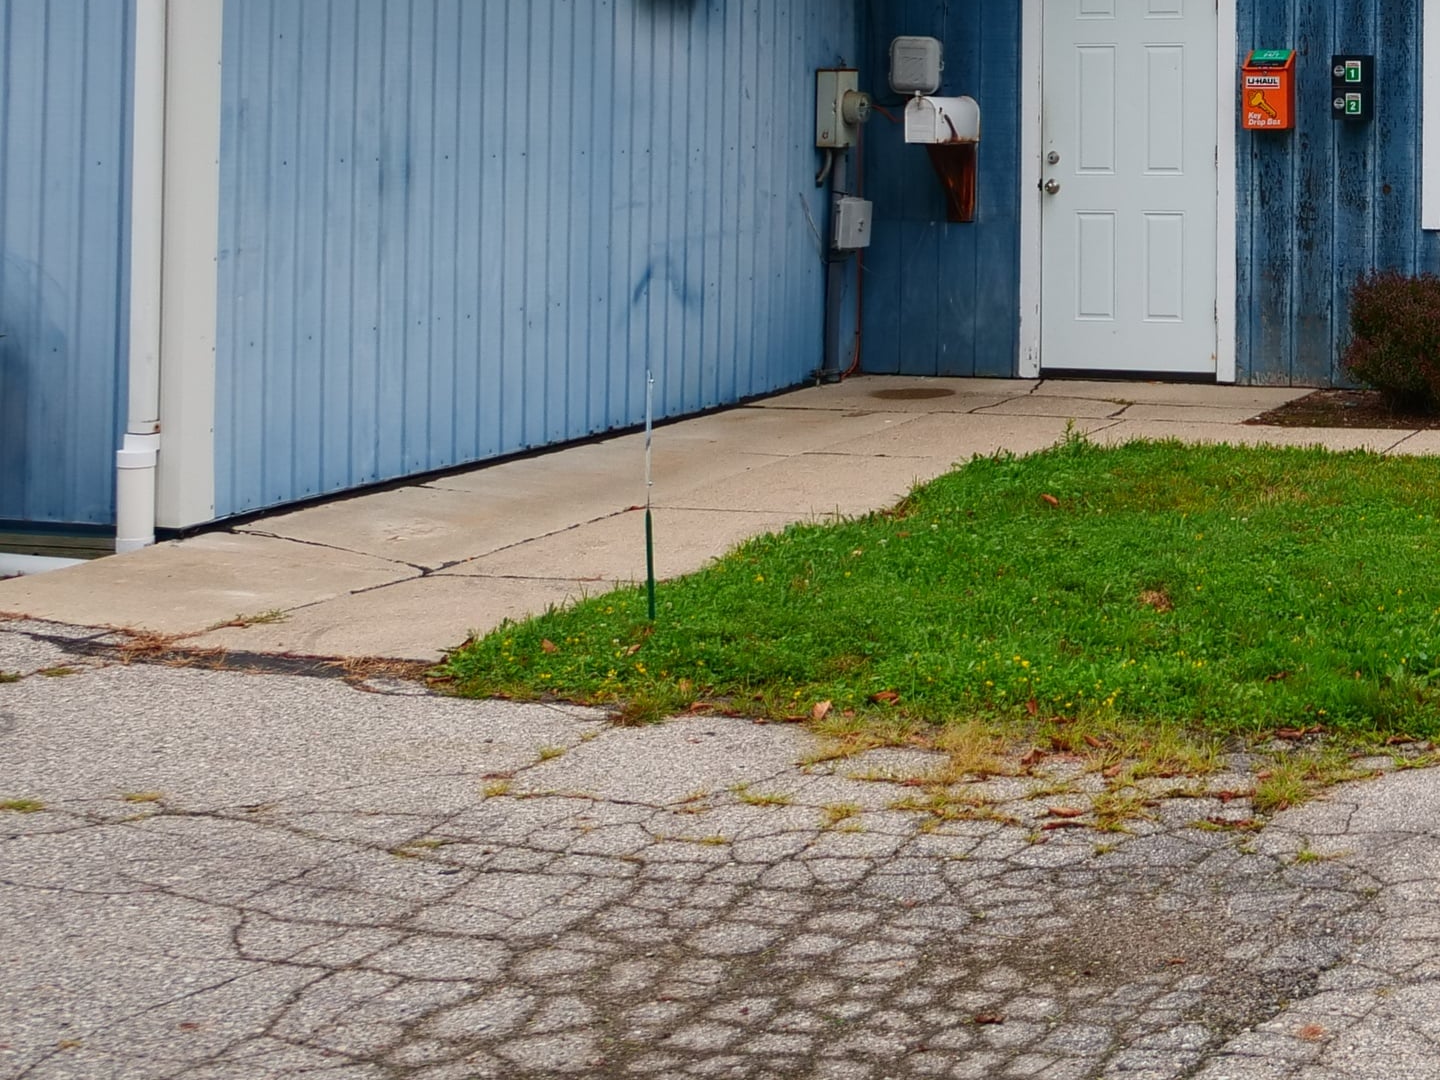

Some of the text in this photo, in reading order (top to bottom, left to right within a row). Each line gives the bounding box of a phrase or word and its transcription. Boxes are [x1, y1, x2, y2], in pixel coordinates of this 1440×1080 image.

[1350, 69, 1355, 78] 1
[1350, 101, 1356, 111] 2
[1248, 112, 1262, 120] Key
[1248, 118, 1281, 127] Drop Box
